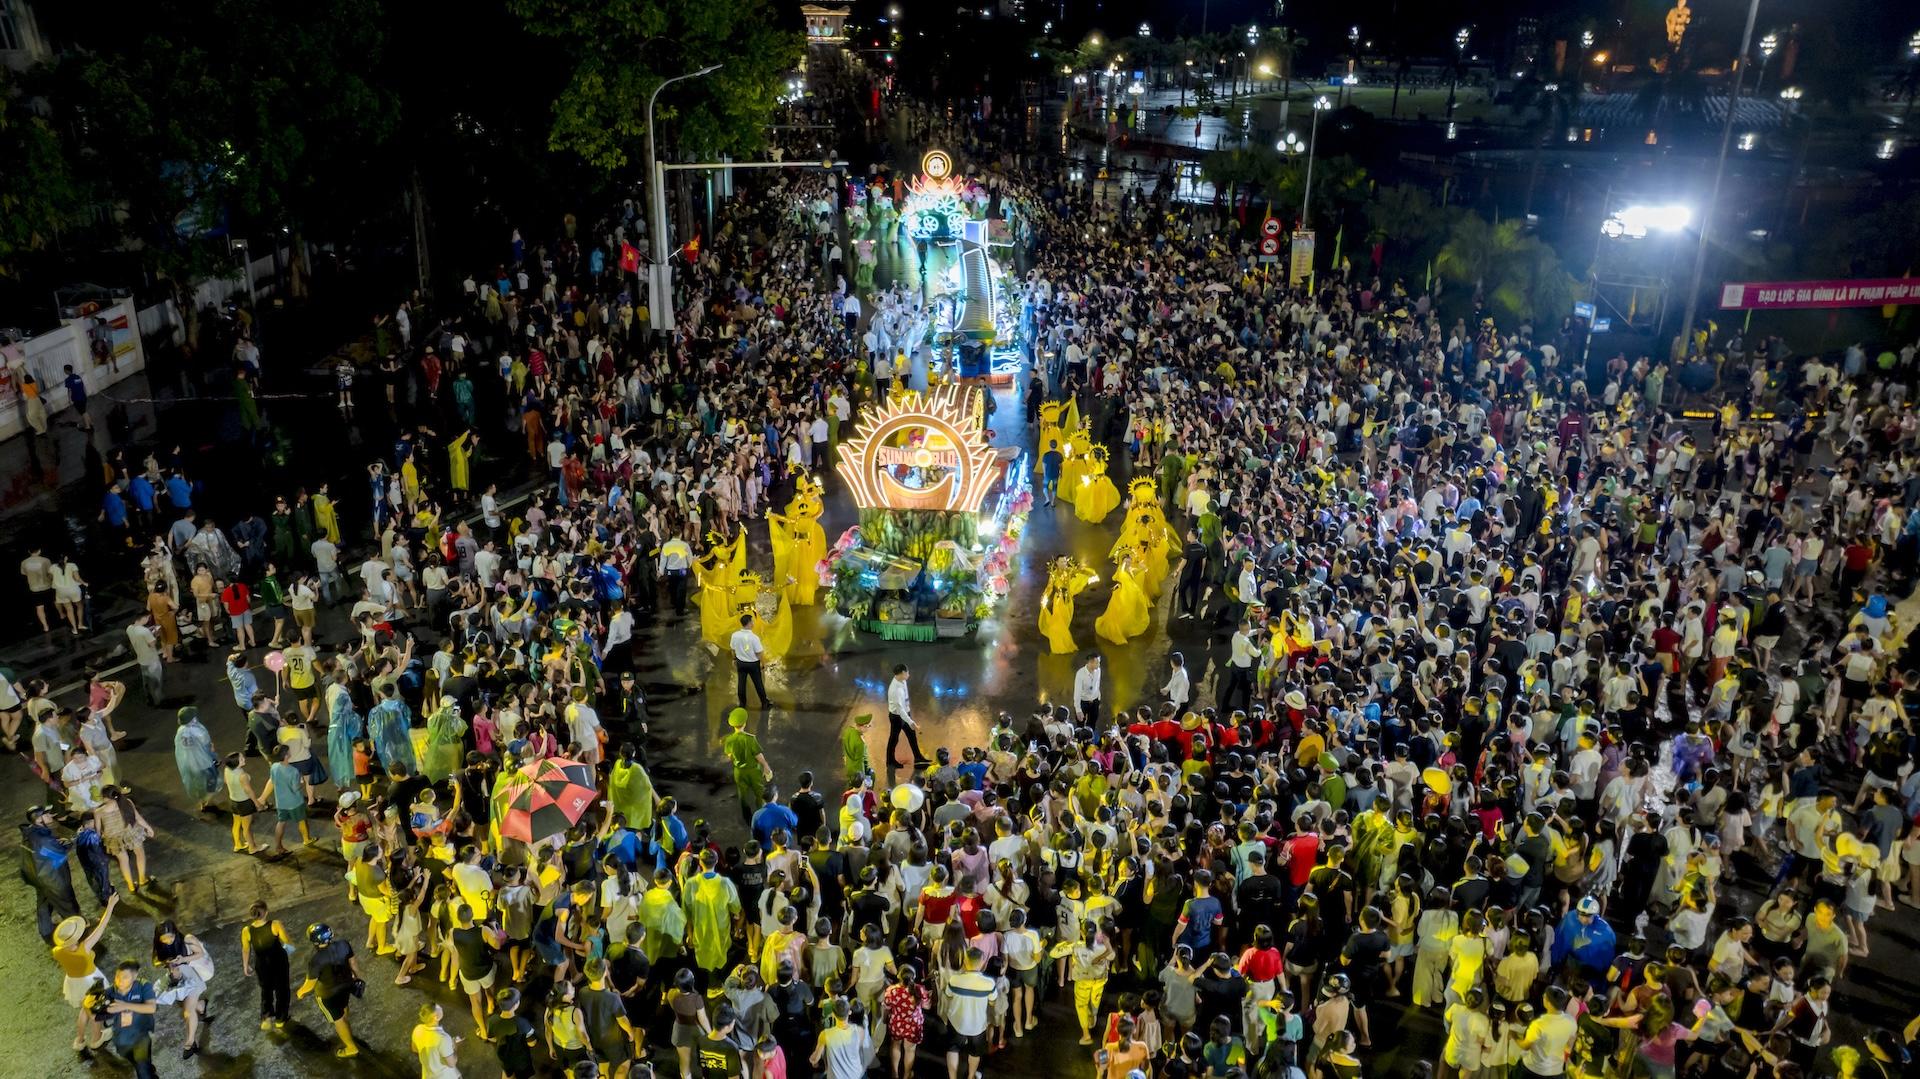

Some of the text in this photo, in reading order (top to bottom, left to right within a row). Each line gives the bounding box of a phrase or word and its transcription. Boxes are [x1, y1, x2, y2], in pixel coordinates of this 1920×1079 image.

[1758, 289, 1777, 304] BẠO
[1777, 288, 1795, 304] LỰC
[1796, 288, 1811, 301] GIA
[1835, 286, 1847, 301] LÀ
[1848, 287, 1858, 300] VI
[1858, 286, 1885, 302] PHẠM
[1885, 284, 1909, 299] PHÁP
[292, 657, 304, 671] 20
